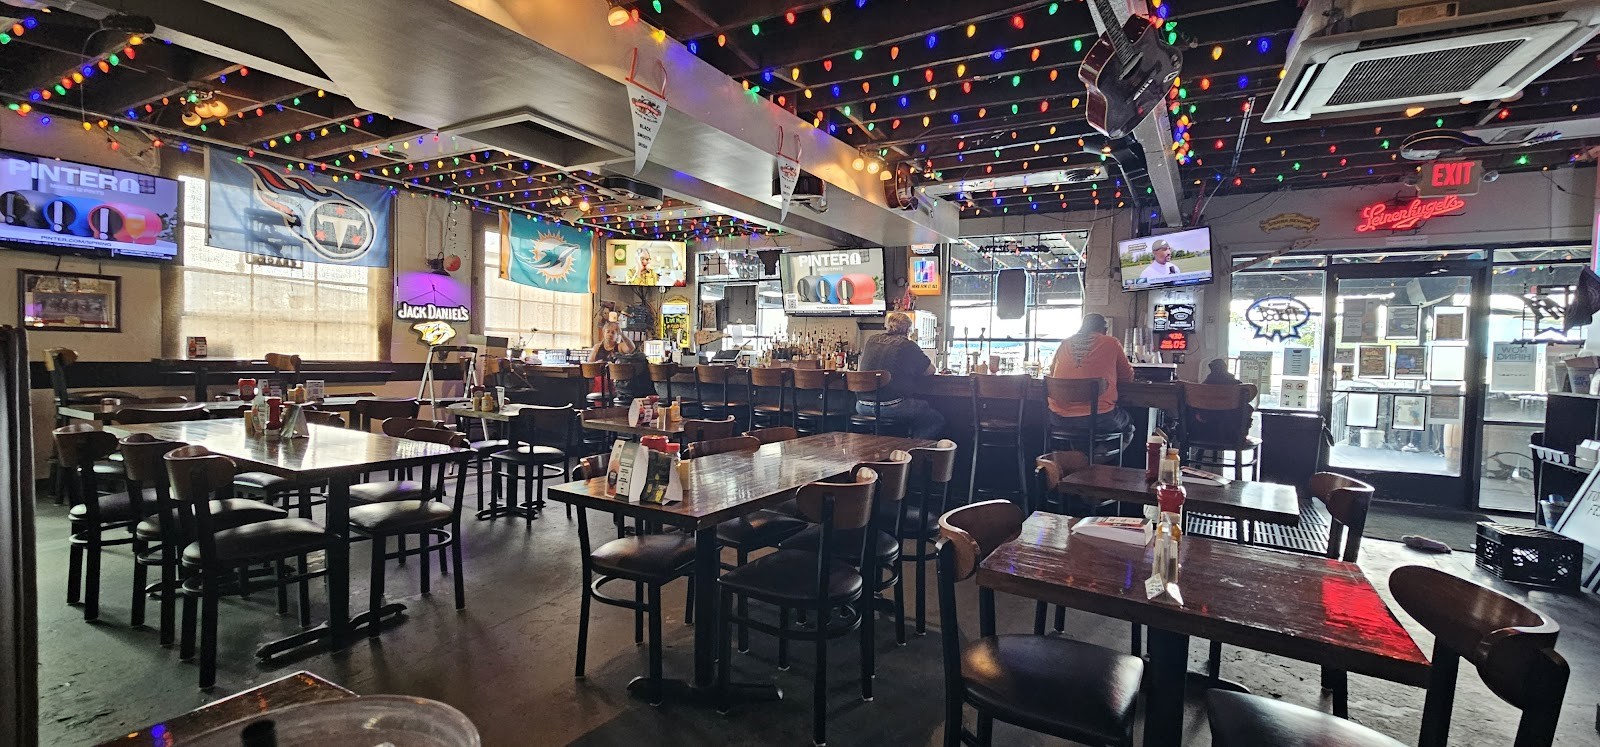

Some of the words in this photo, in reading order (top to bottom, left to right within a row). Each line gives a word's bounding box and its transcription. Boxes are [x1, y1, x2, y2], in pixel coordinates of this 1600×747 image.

[9, 158, 118, 192] PINTER
[1431, 161, 1475, 187] EXIT
[799, 252, 850, 268] PINTER
[397, 302, 427, 319] JACK
[427, 304, 469, 321] DANIEL'S
